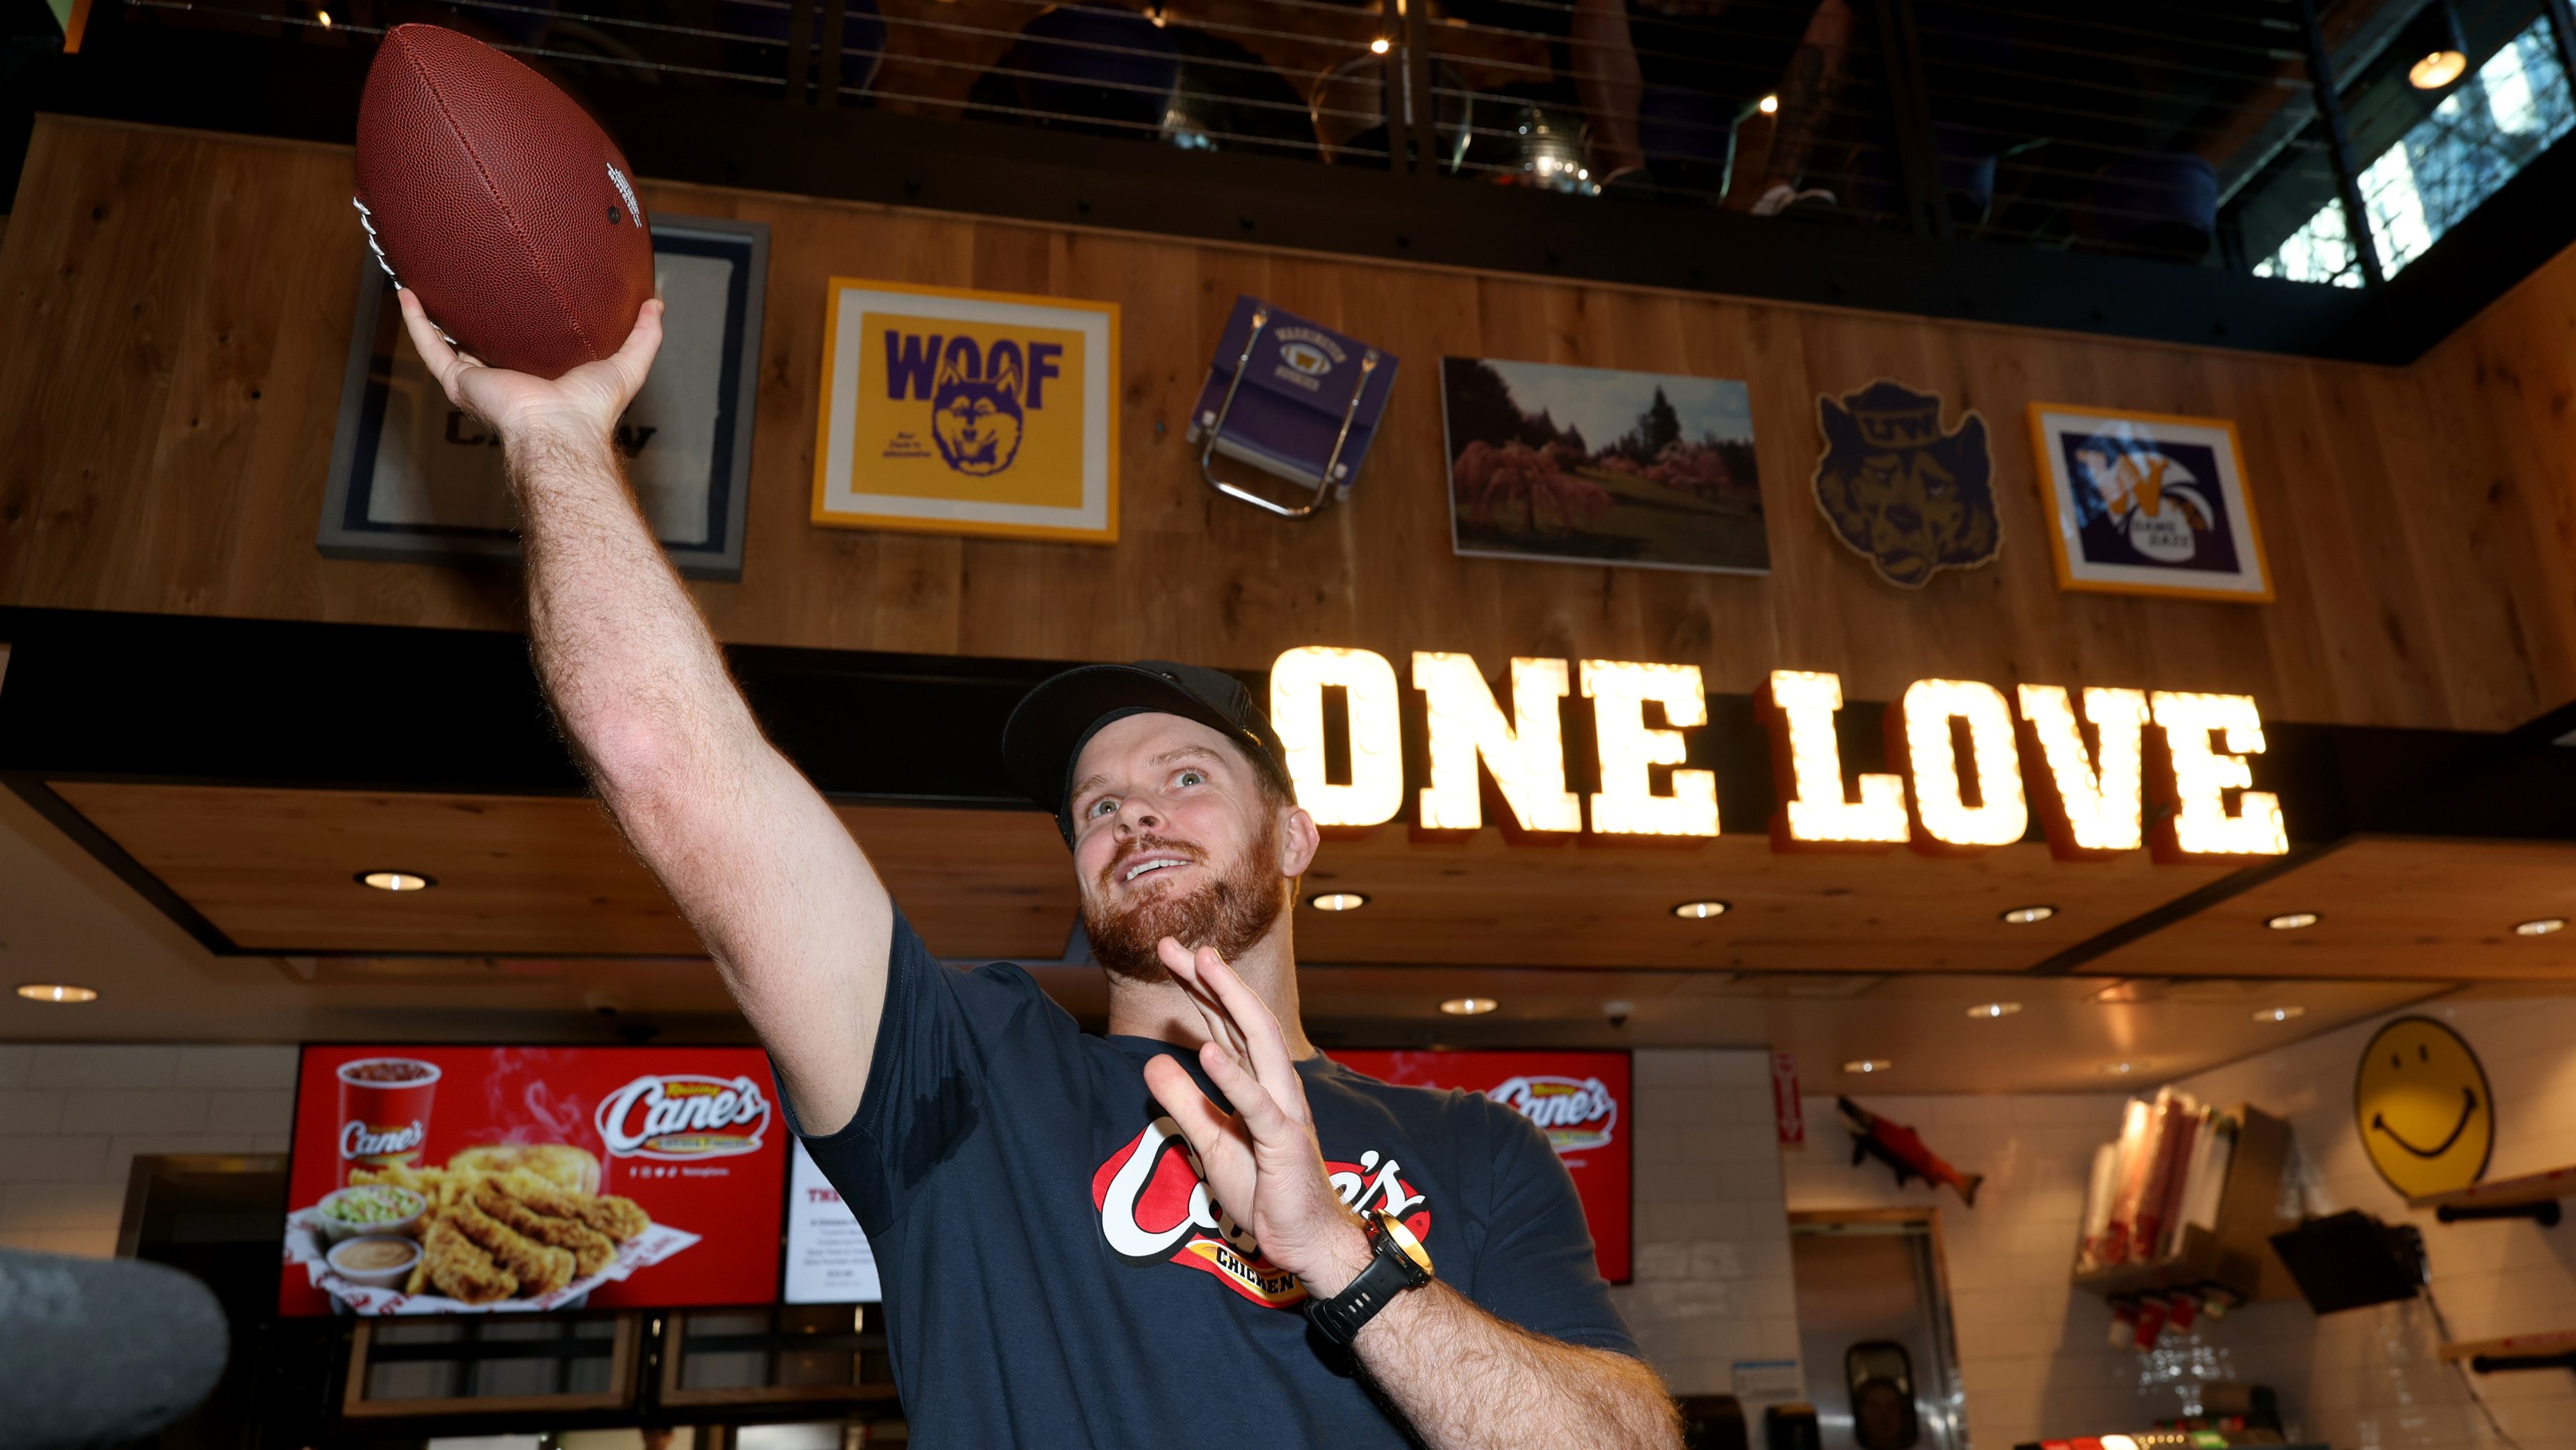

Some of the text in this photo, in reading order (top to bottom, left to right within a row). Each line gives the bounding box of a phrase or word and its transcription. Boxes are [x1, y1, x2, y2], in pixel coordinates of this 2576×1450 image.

[884, 330, 1063, 410] WOOF
[1862, 415, 1934, 441] UW
[1269, 645, 2290, 856] ONE LOVE
[339, 1119, 424, 1161] Cane's
[606, 1077, 769, 1153] Cane's
[1102, 1116, 1426, 1257] Cae's
[1217, 1246, 1294, 1294] CHICKEN
